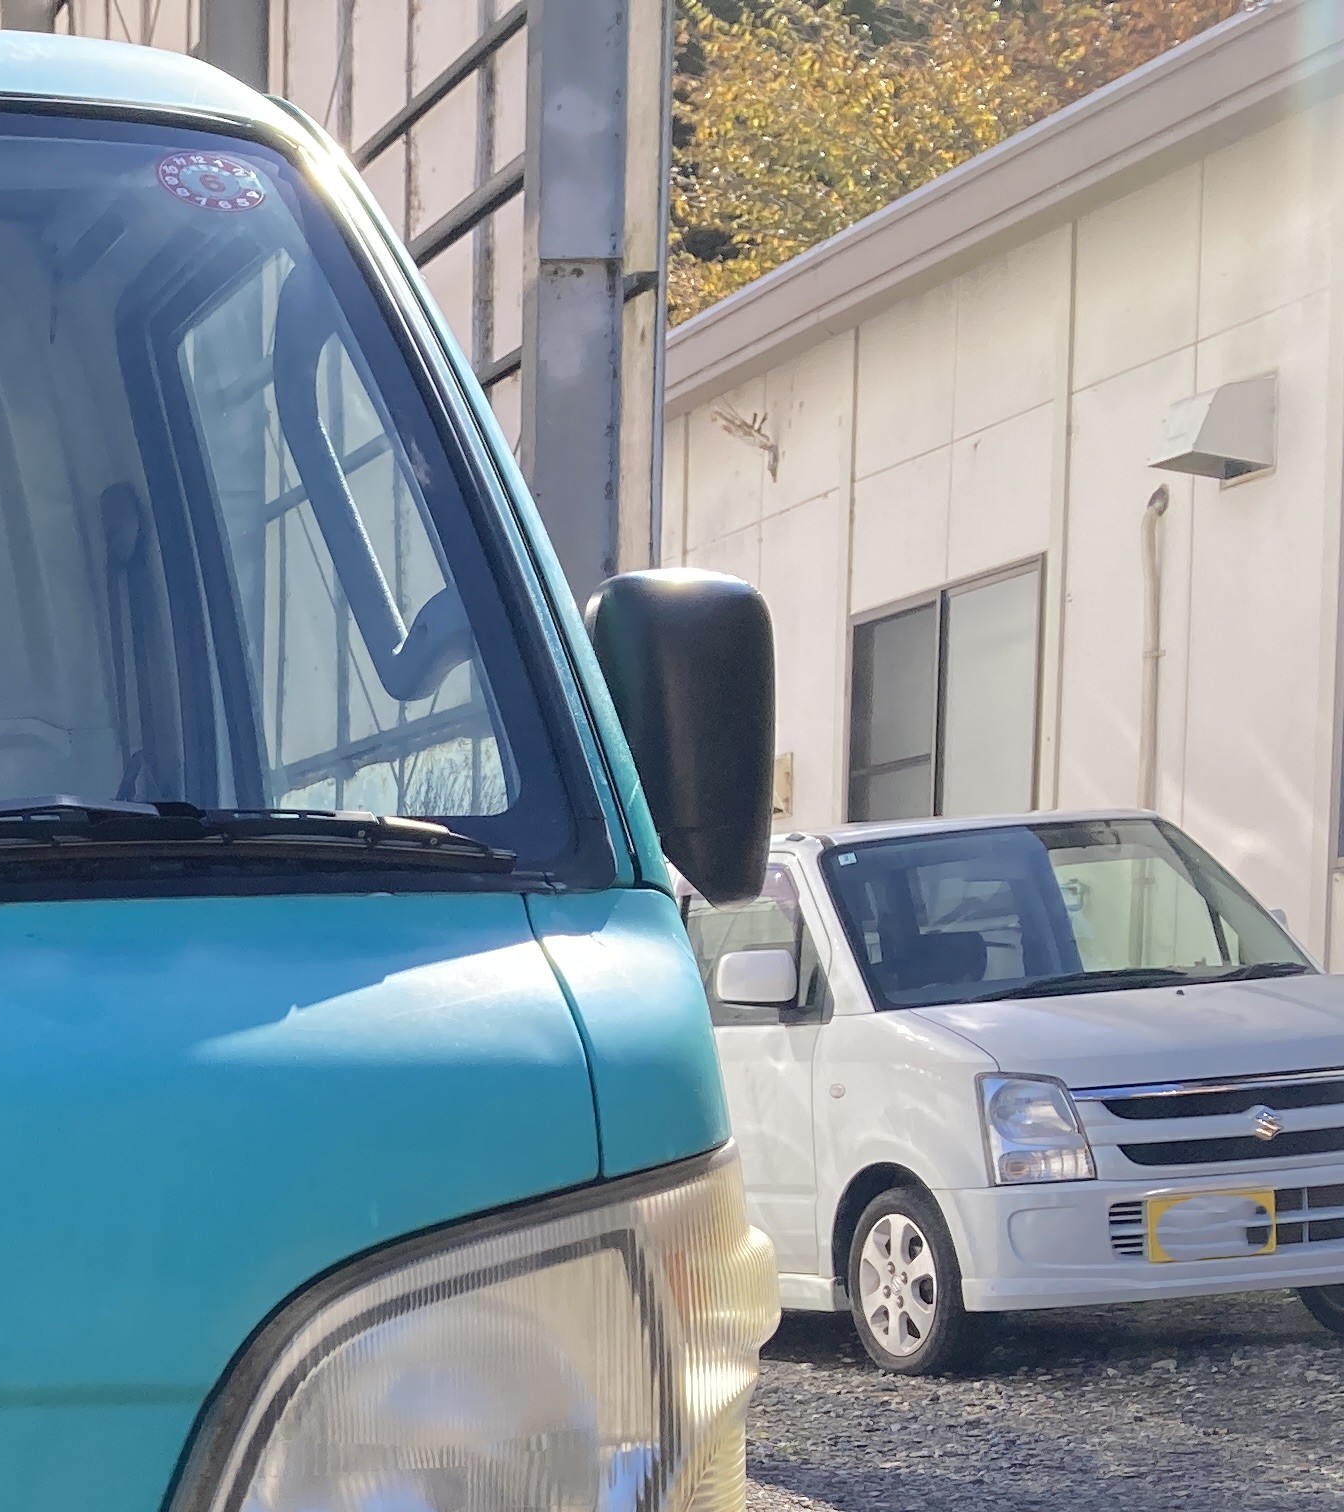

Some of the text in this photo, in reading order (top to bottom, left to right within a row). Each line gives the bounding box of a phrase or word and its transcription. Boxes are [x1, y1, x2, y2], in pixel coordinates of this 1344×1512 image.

[190, 156, 207, 164] 12
[214, 160, 224, 168] 1
[233, 168, 247, 176] 2
